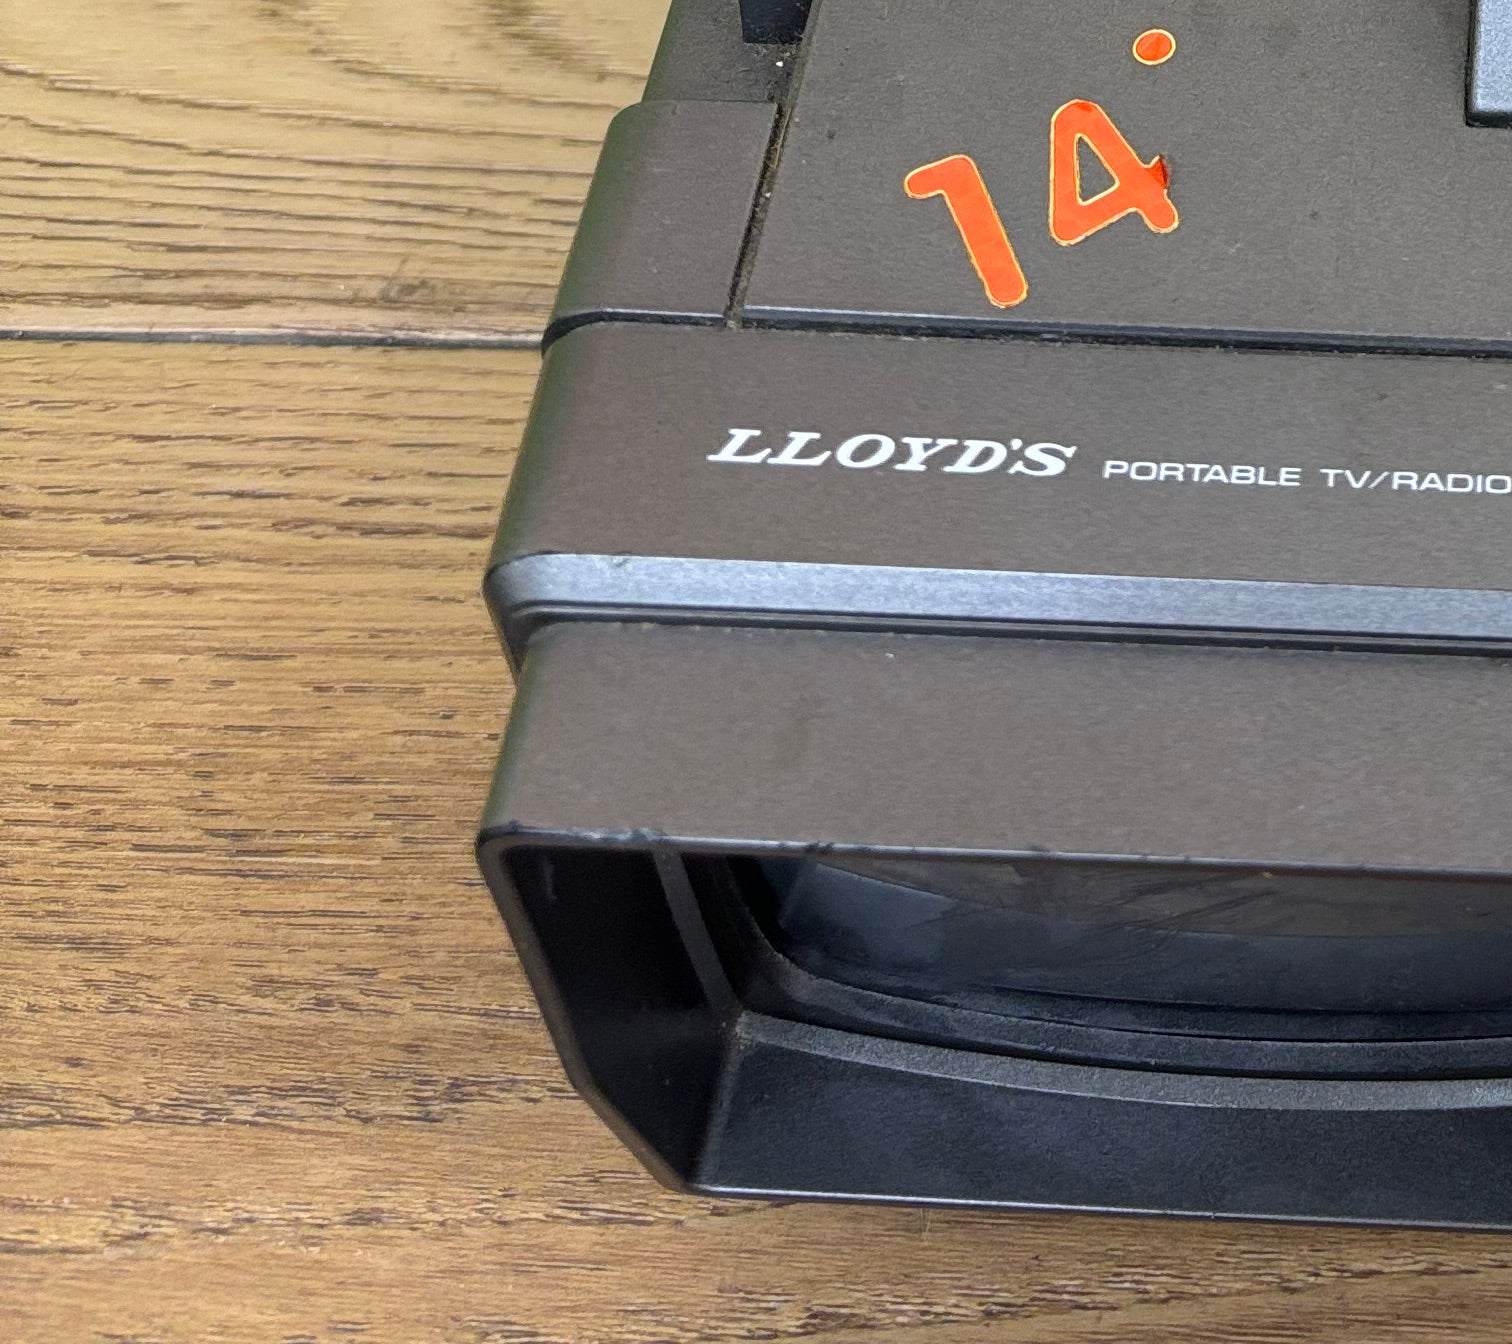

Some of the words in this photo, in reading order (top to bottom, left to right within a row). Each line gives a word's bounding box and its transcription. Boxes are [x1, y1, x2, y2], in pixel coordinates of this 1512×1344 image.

[706, 428, 1078, 477] LLOYD'S
[1102, 459, 1302, 486] PORTABLE
[1319, 468, 1512, 494] TV/RADIO
